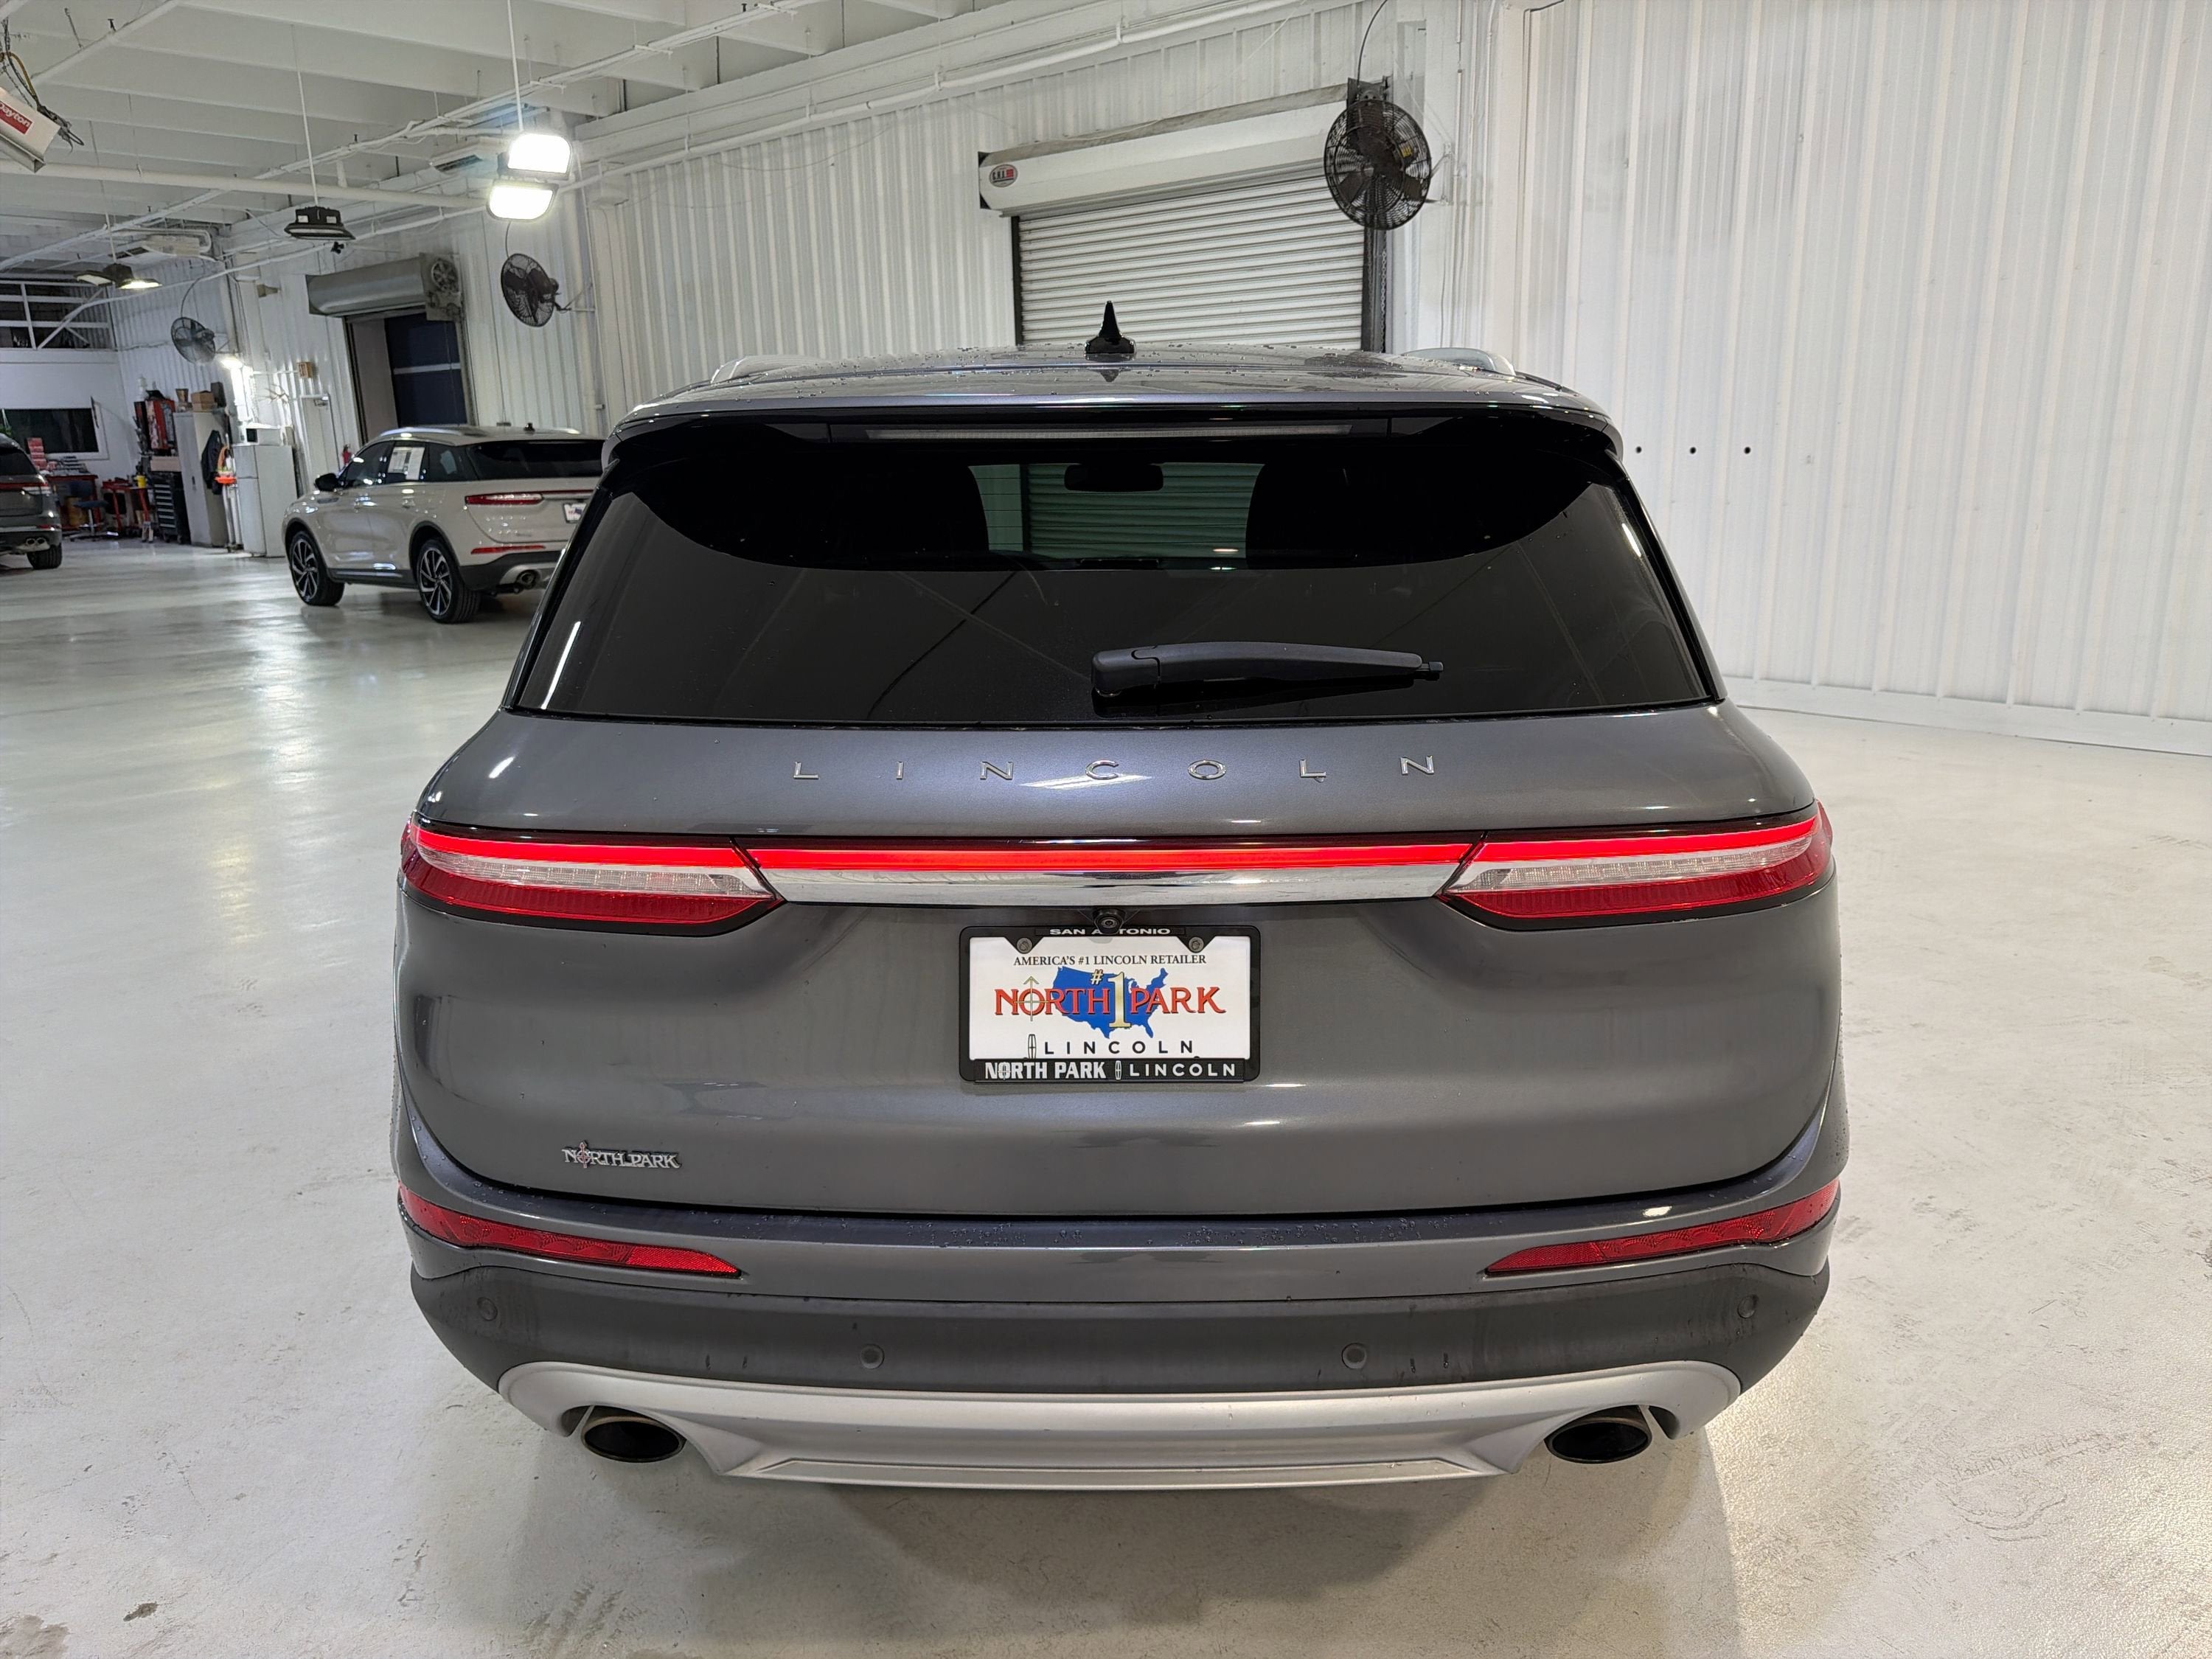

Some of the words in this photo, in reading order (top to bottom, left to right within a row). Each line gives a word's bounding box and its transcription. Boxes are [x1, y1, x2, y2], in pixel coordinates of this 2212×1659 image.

[793, 755, 1434, 780] LINCOLN
[1014, 955, 1076, 966] AMERICA'S
[1078, 956, 1091, 965] #1
[1093, 955, 1147, 965] LINCOLN
[1150, 954, 1207, 964] RETAILER
[994, 988, 1110, 1016] NORTH
[1130, 987, 1226, 1014] PARK
[1044, 1040, 1193, 1055] LINCOLN
[985, 1062, 1048, 1079] NORTH
[1055, 1062, 1106, 1079] PARK
[1130, 1063, 1236, 1077] LINCOLN
[561, 1148, 626, 1166] NORTH
[627, 1152, 681, 1168] PARK
